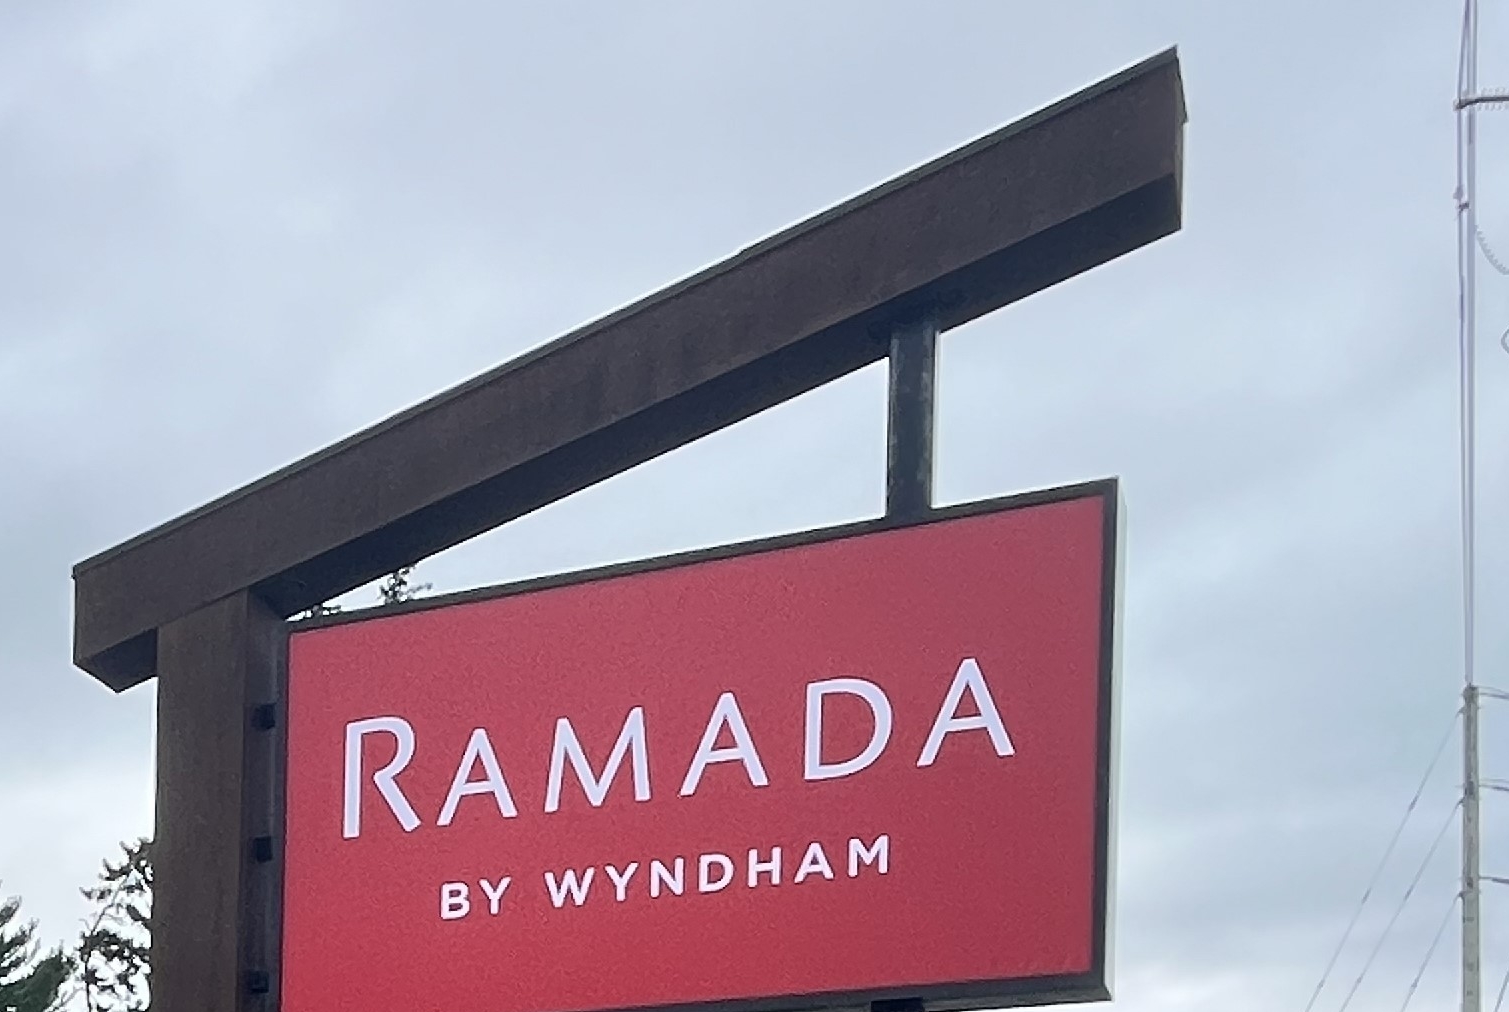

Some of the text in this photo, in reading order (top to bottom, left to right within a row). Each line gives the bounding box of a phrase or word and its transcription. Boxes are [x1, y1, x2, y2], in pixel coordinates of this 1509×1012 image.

[341, 657, 1016, 839] RAMADA
[440, 834, 890, 920] BY WYNDHAM
